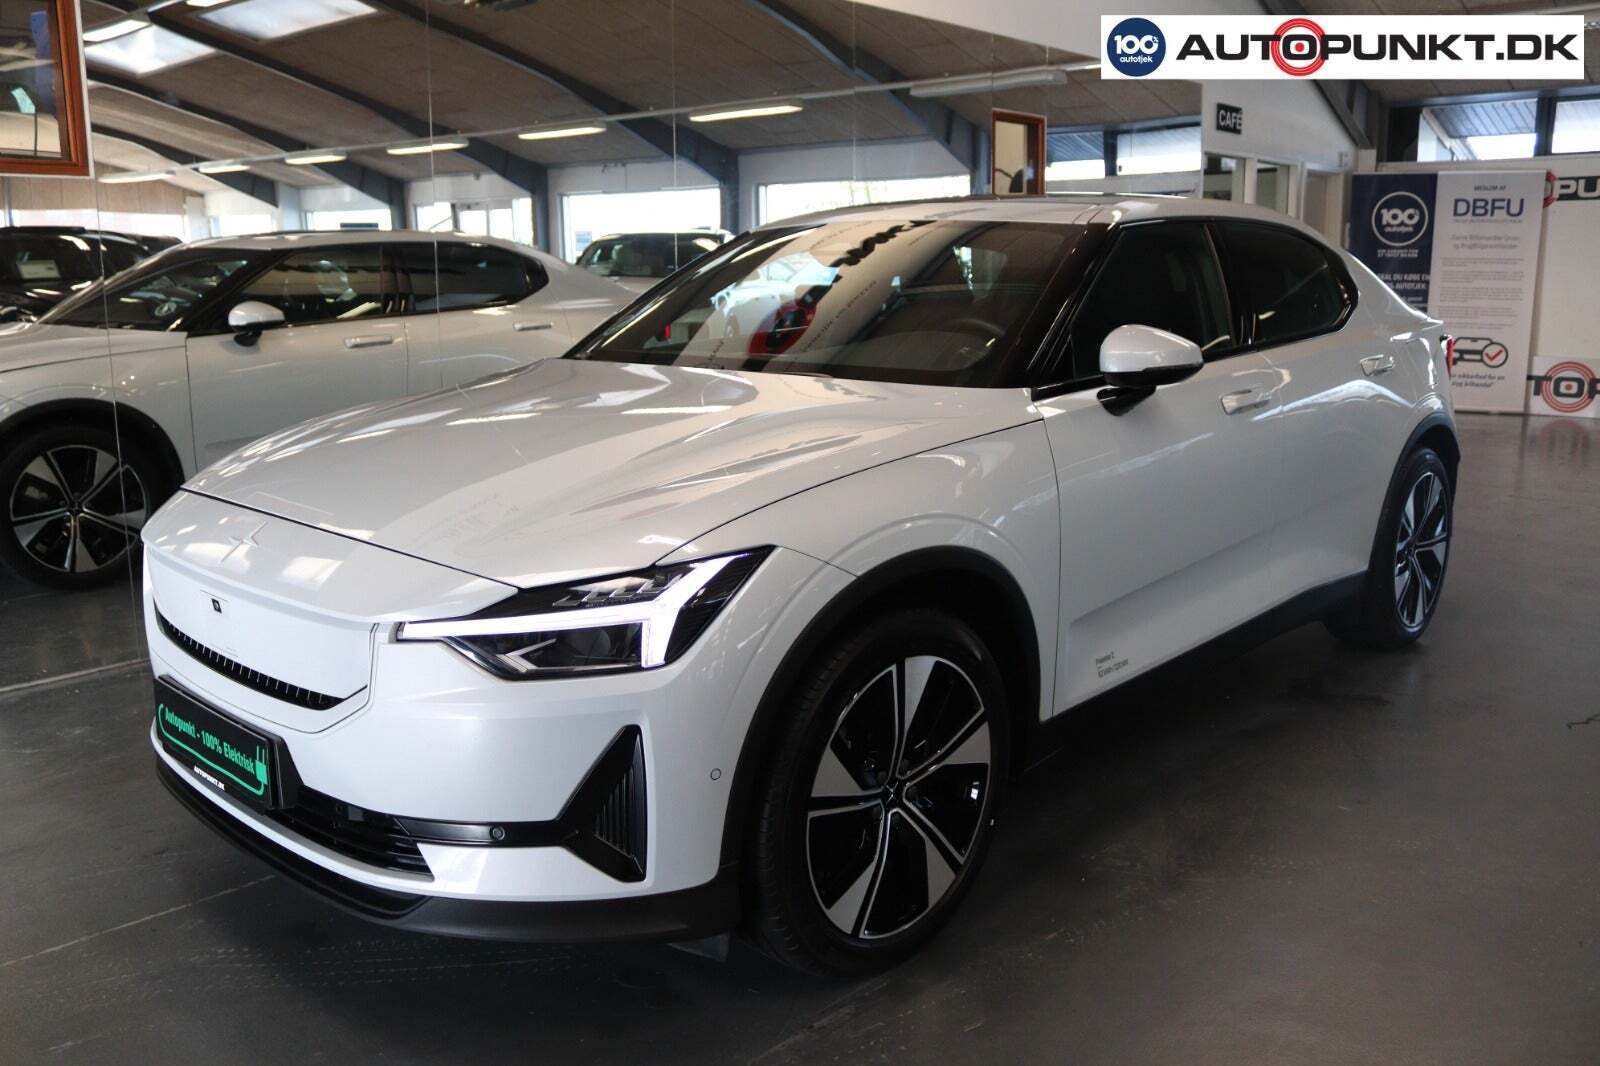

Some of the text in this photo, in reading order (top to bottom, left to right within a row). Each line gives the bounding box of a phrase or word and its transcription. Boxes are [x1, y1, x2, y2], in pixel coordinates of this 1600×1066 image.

[1453, 198, 1525, 217] DBFU
[165, 706, 196, 739] Autopunkt
[201, 730, 222, 755] 100%
[223, 742, 255, 775] Elektrisk
